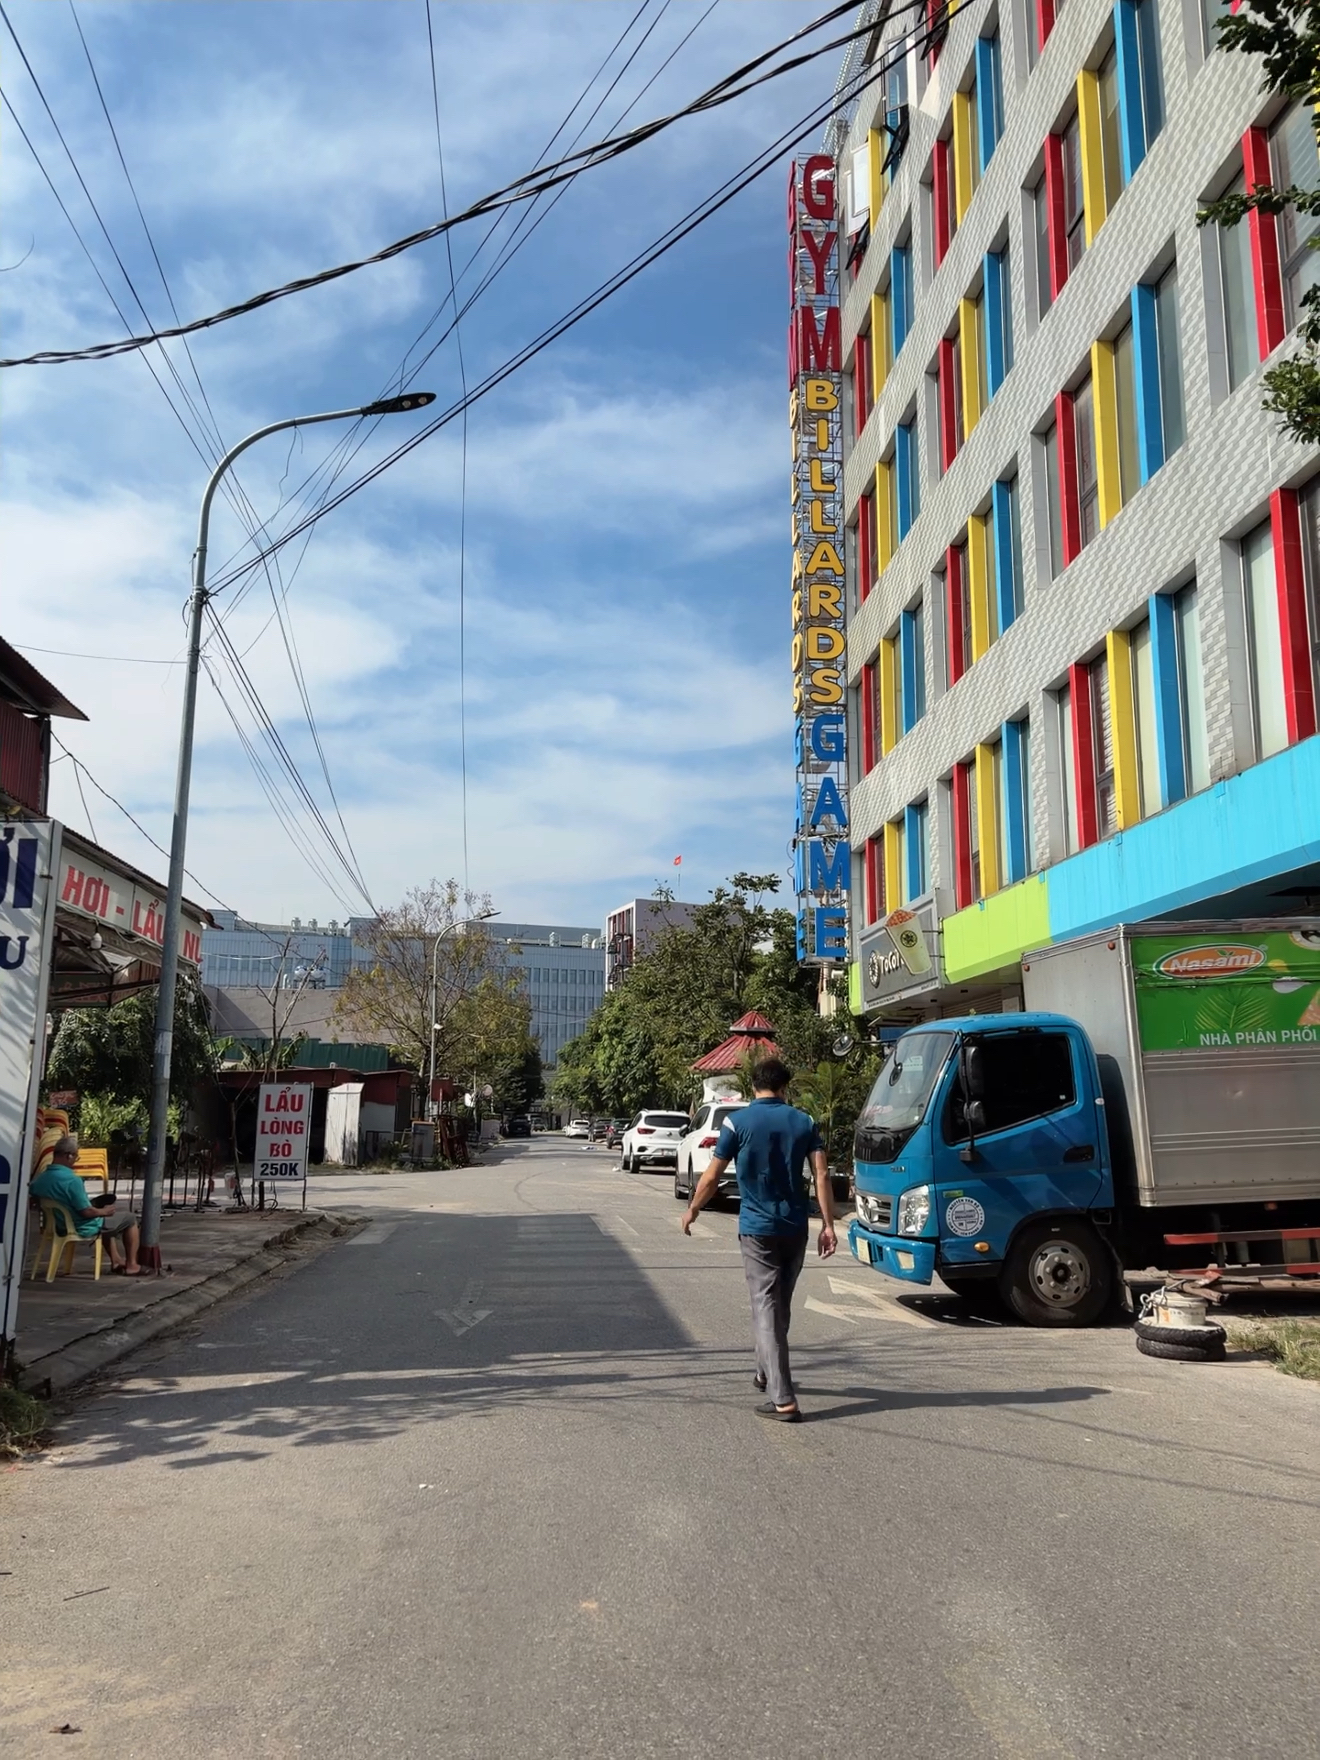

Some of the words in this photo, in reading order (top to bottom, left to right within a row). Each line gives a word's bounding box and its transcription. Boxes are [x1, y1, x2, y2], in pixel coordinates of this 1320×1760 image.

[801, 155, 841, 372] GYM
[804, 377, 846, 704] BILLARDS
[809, 713, 851, 958] GAME
[62, 864, 110, 918] HƠI
[1169, 950, 1258, 973] Nasami
[1200, 1030, 1231, 1046] NHÀ
[1235, 1028, 1276, 1044] PHÂN
[1281, 1024, 1317, 1042] PHỐI
[264, 1086, 304, 1112] LẨU
[260, 1117, 305, 1135] LÒNG
[269, 1139, 292, 1157] BÒ
[259, 1162, 299, 1176] 250K
